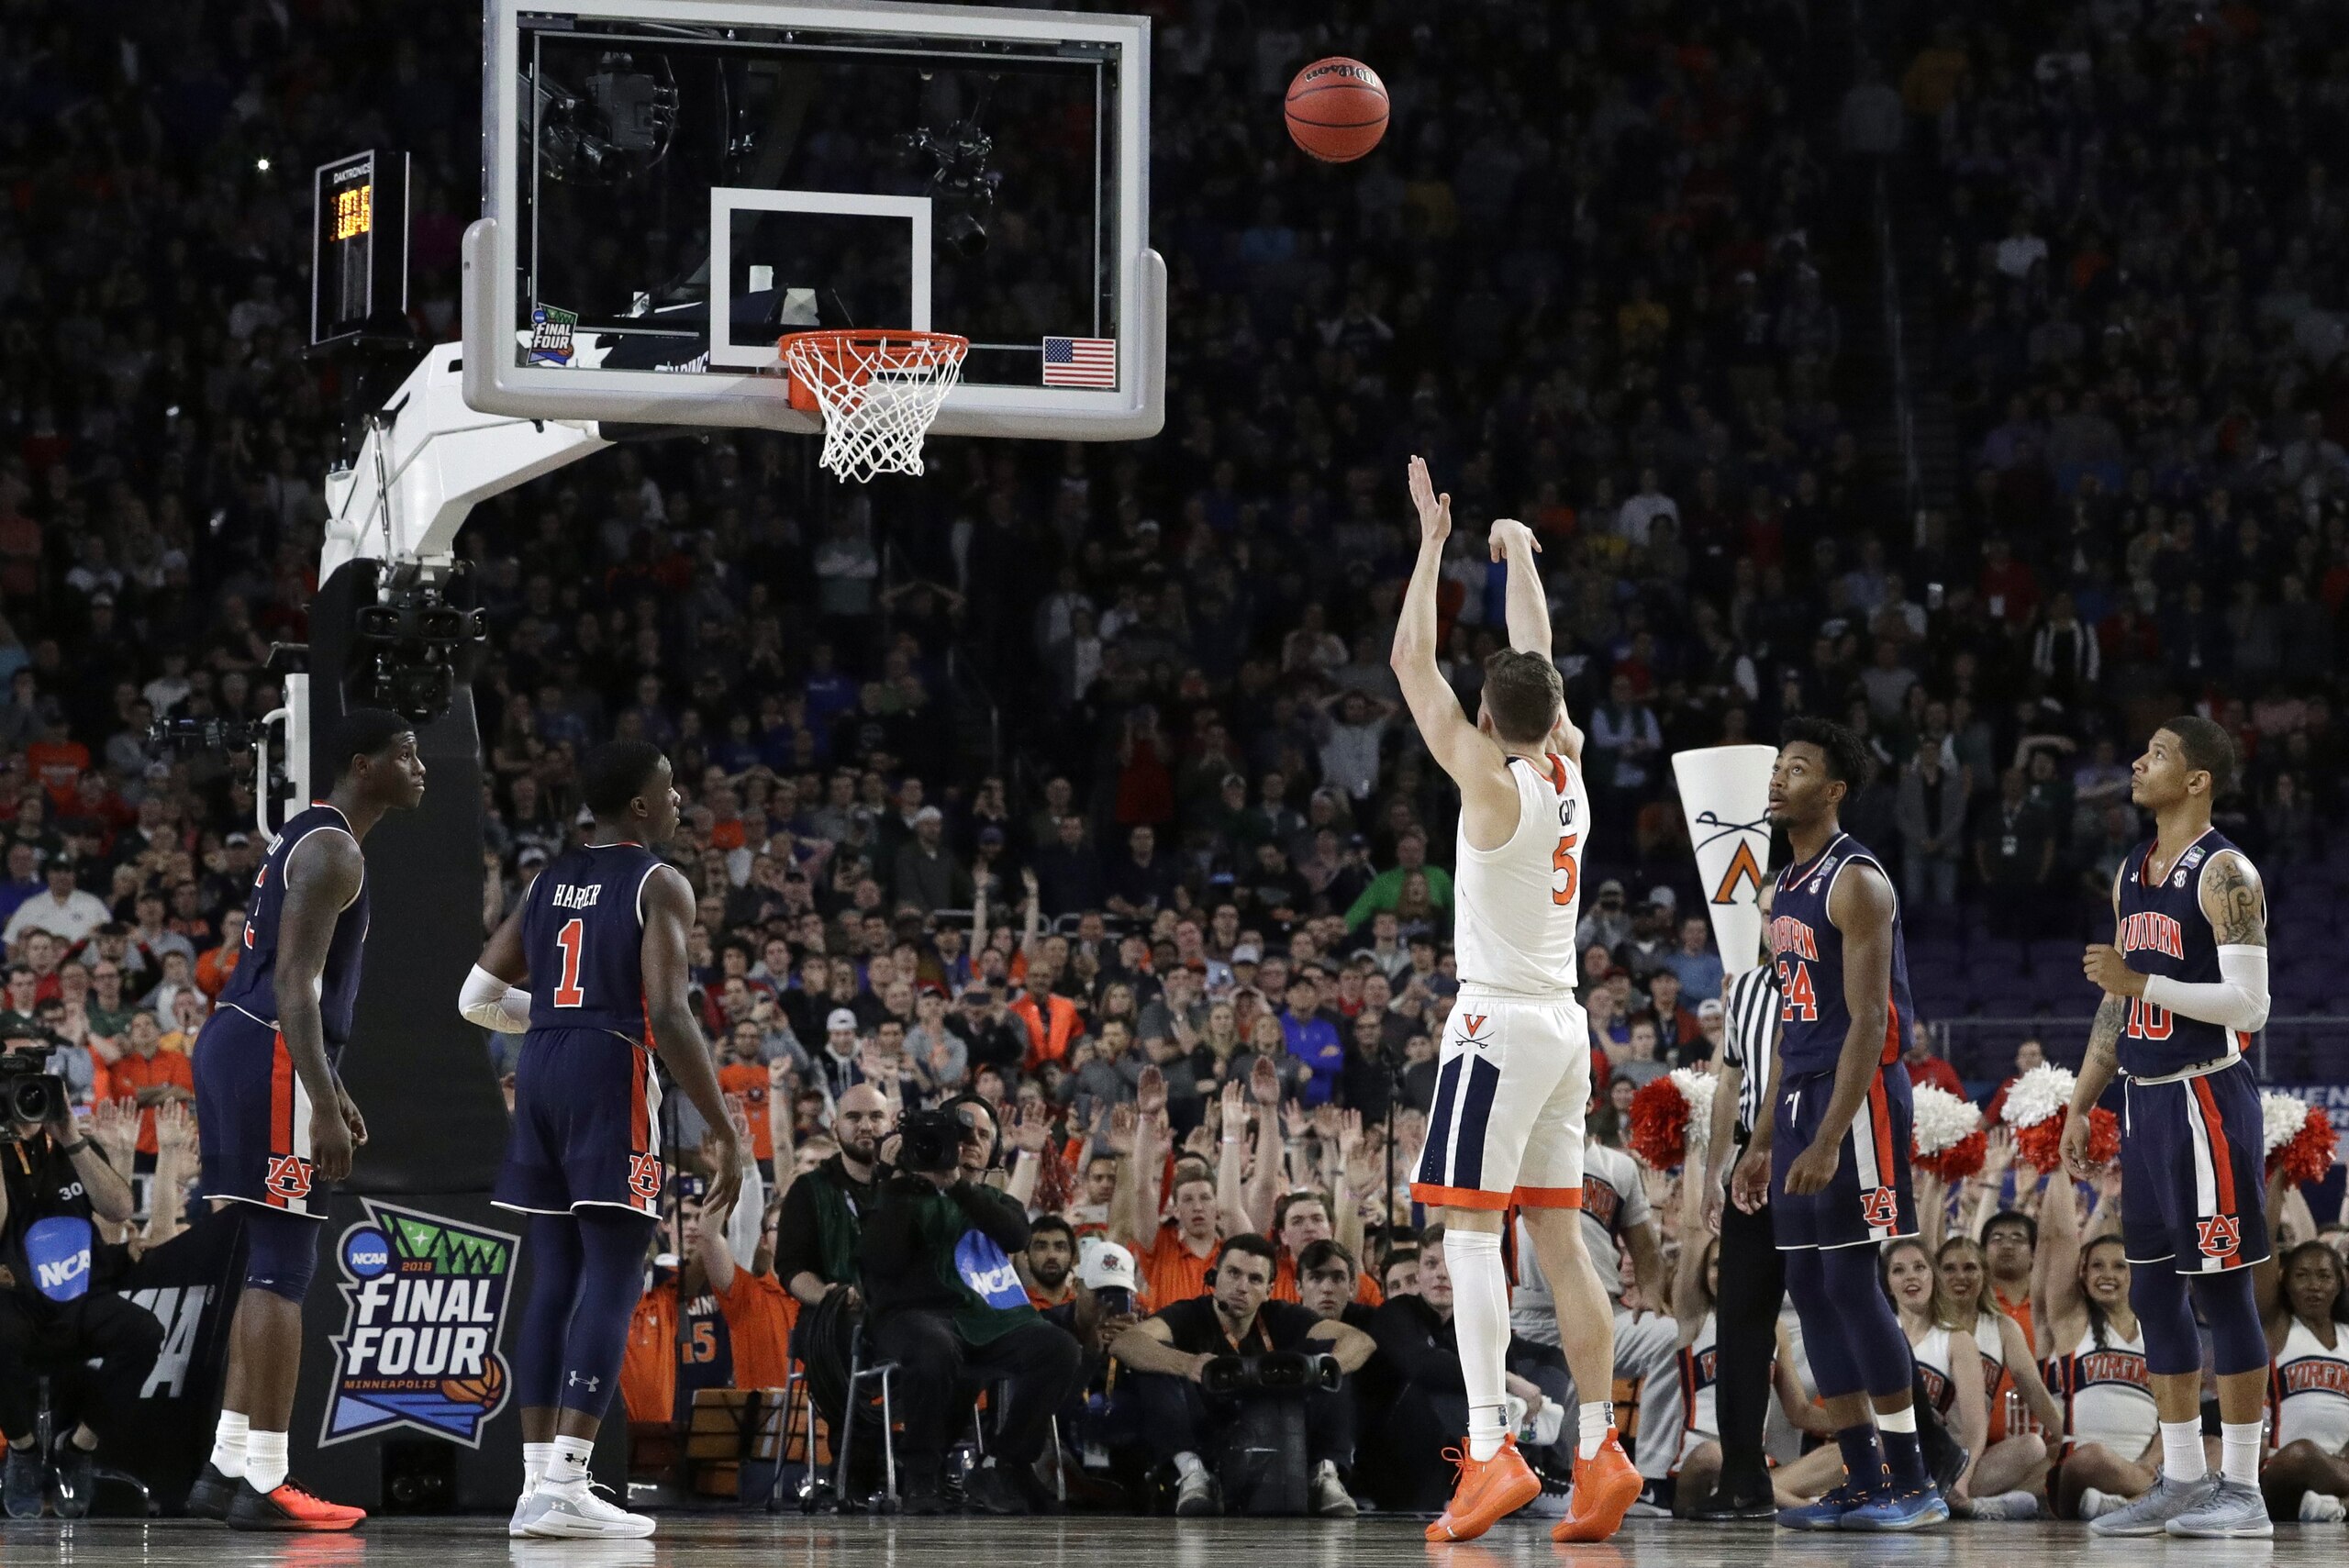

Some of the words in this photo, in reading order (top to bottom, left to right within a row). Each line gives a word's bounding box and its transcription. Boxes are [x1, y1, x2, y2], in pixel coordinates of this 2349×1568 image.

[536, 321, 571, 336] FINAL
[533, 335, 570, 349] FOUR
[1552, 832, 1577, 906] 5
[554, 918, 584, 1008] 1
[59, 1182, 83, 1201] 30
[351, 1252, 387, 1265] NCAA
[402, 1262, 432, 1272] 2019
[356, 1273, 494, 1326] FINAL
[347, 1327, 488, 1375] FOUR
[344, 1380, 438, 1389] MINNEAPOLIS
